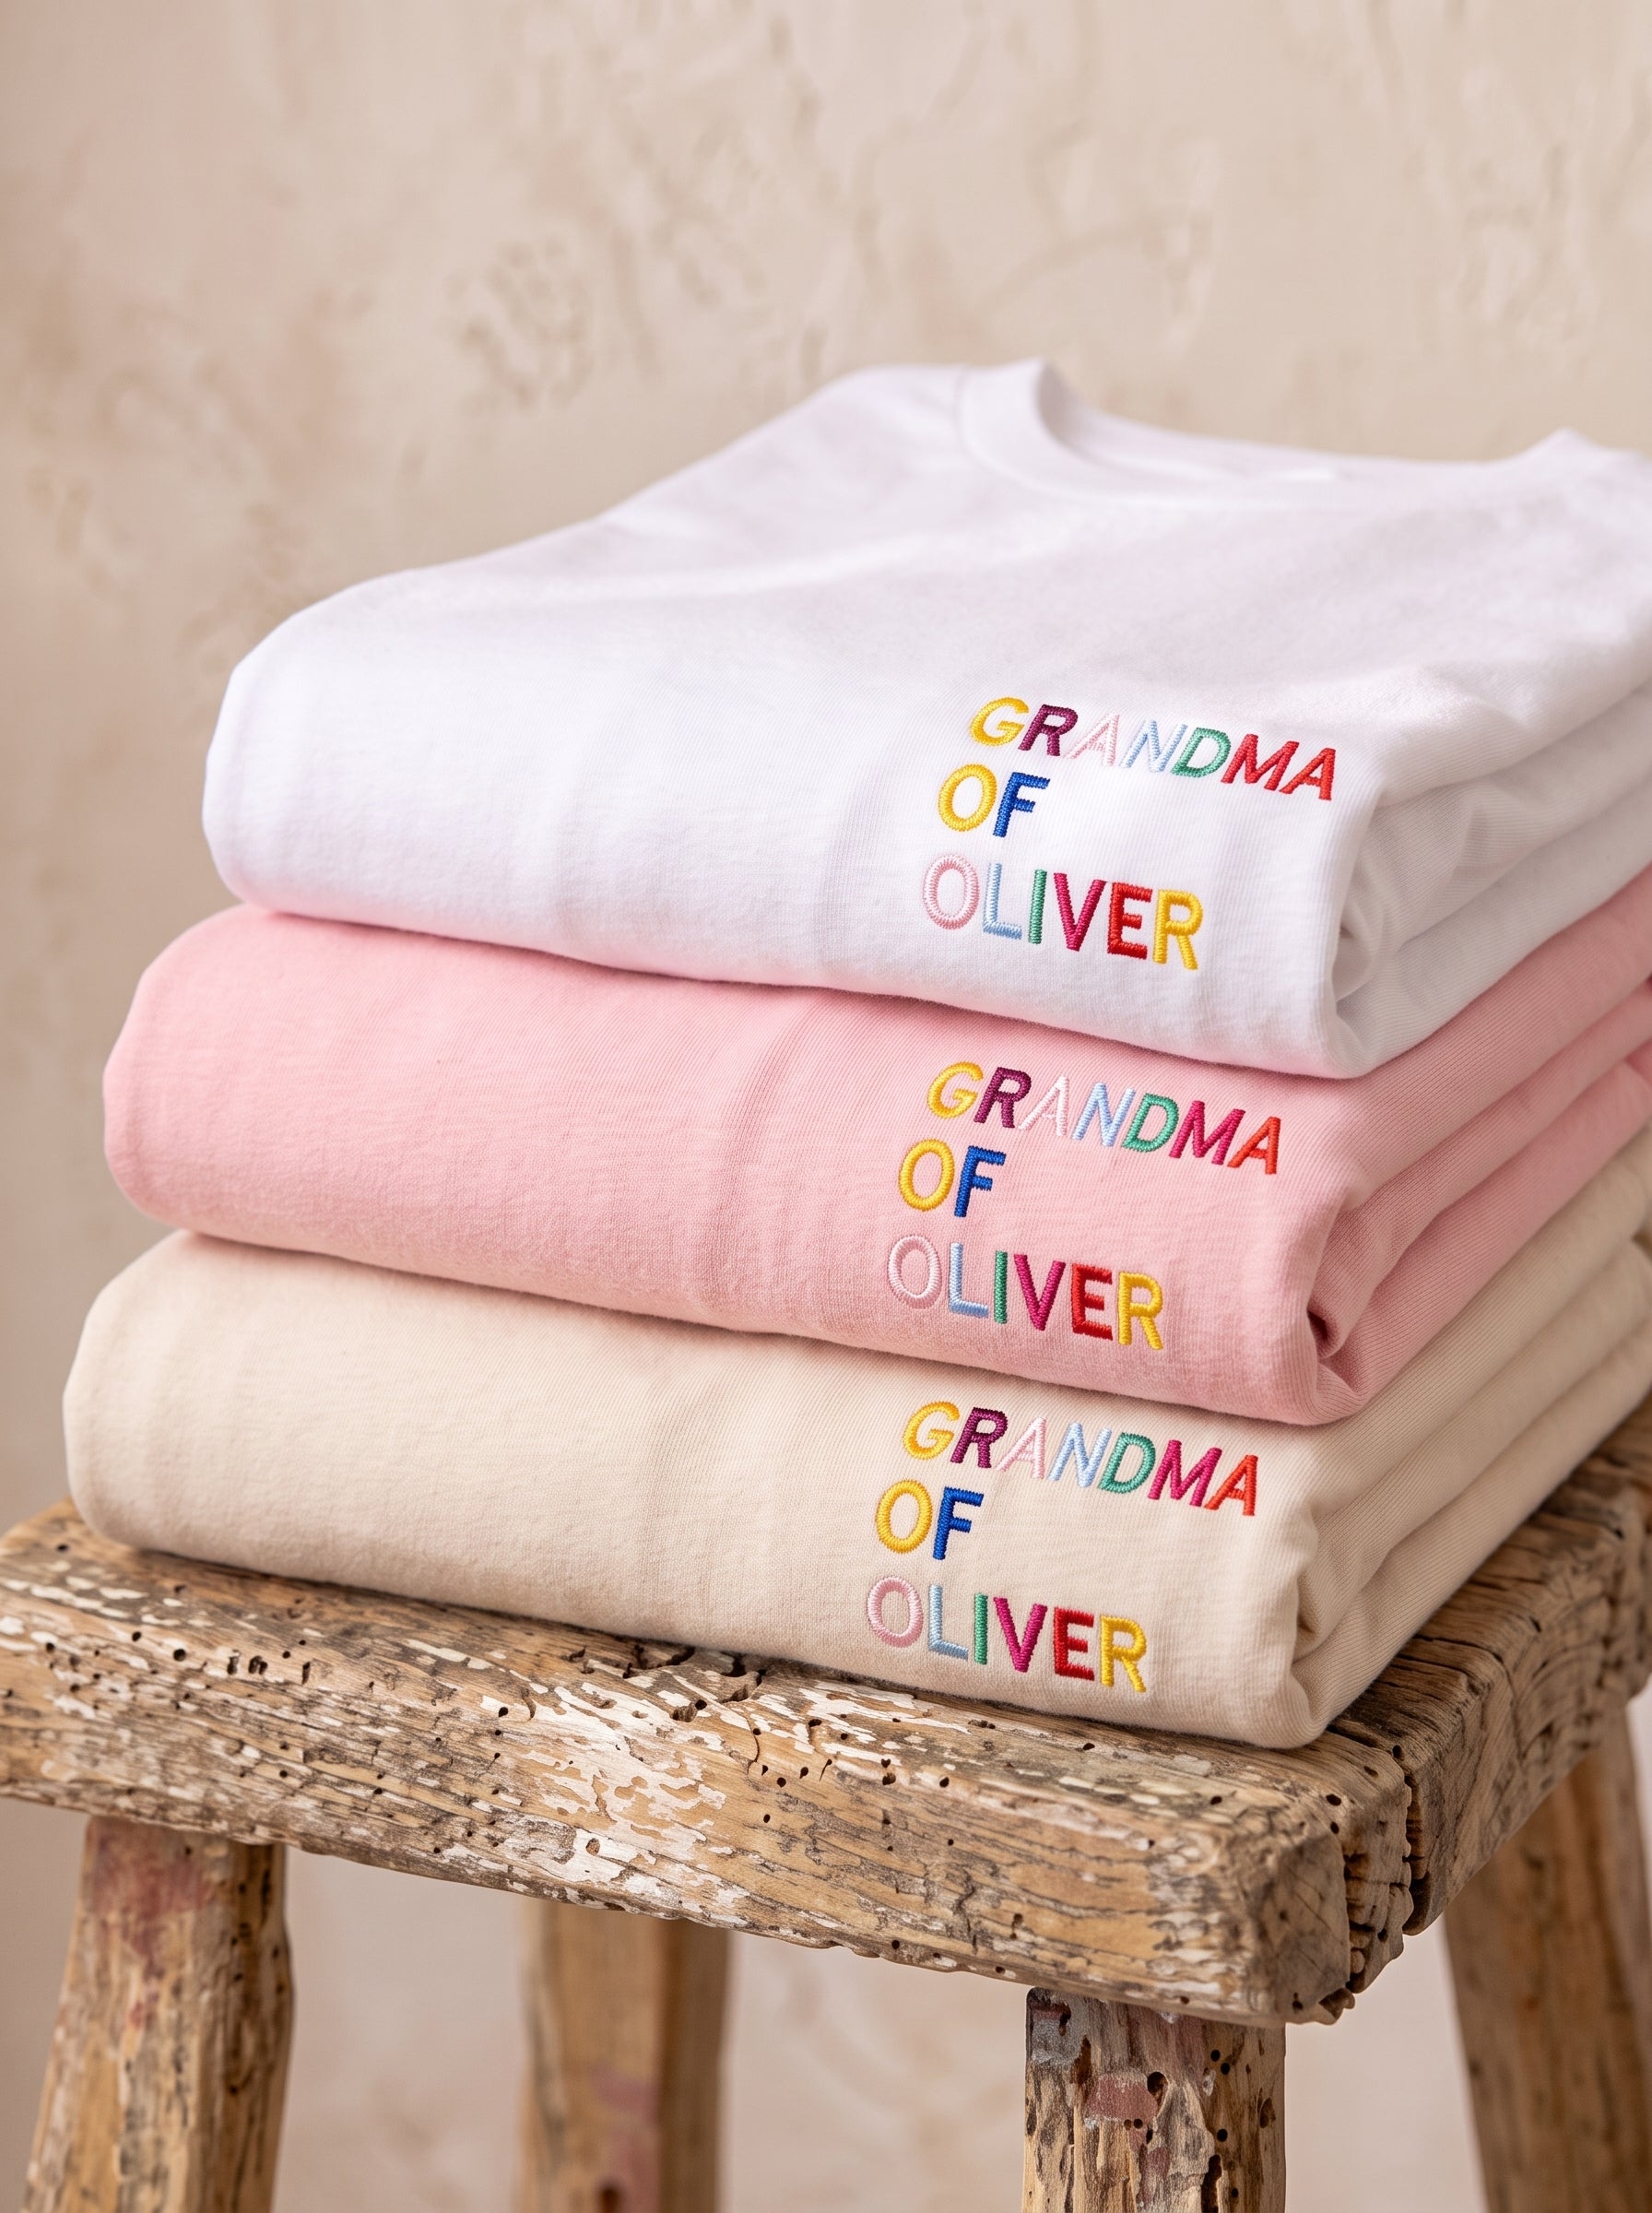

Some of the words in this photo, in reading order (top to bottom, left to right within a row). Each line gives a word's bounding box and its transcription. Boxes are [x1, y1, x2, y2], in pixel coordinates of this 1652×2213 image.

[938, 763, 1050, 837] OF
[969, 697, 1336, 800] GRANDMA
[922, 853, 1203, 970] OLIVER
[926, 1061, 1281, 1175] GRANDMA
[898, 1138, 1006, 1217] OF
[887, 1235, 1163, 1350] OLIVER
[903, 1401, 1258, 1516] GRANDMA
[875, 1479, 984, 1560] OF
[867, 1576, 1147, 1692] OLIVER
